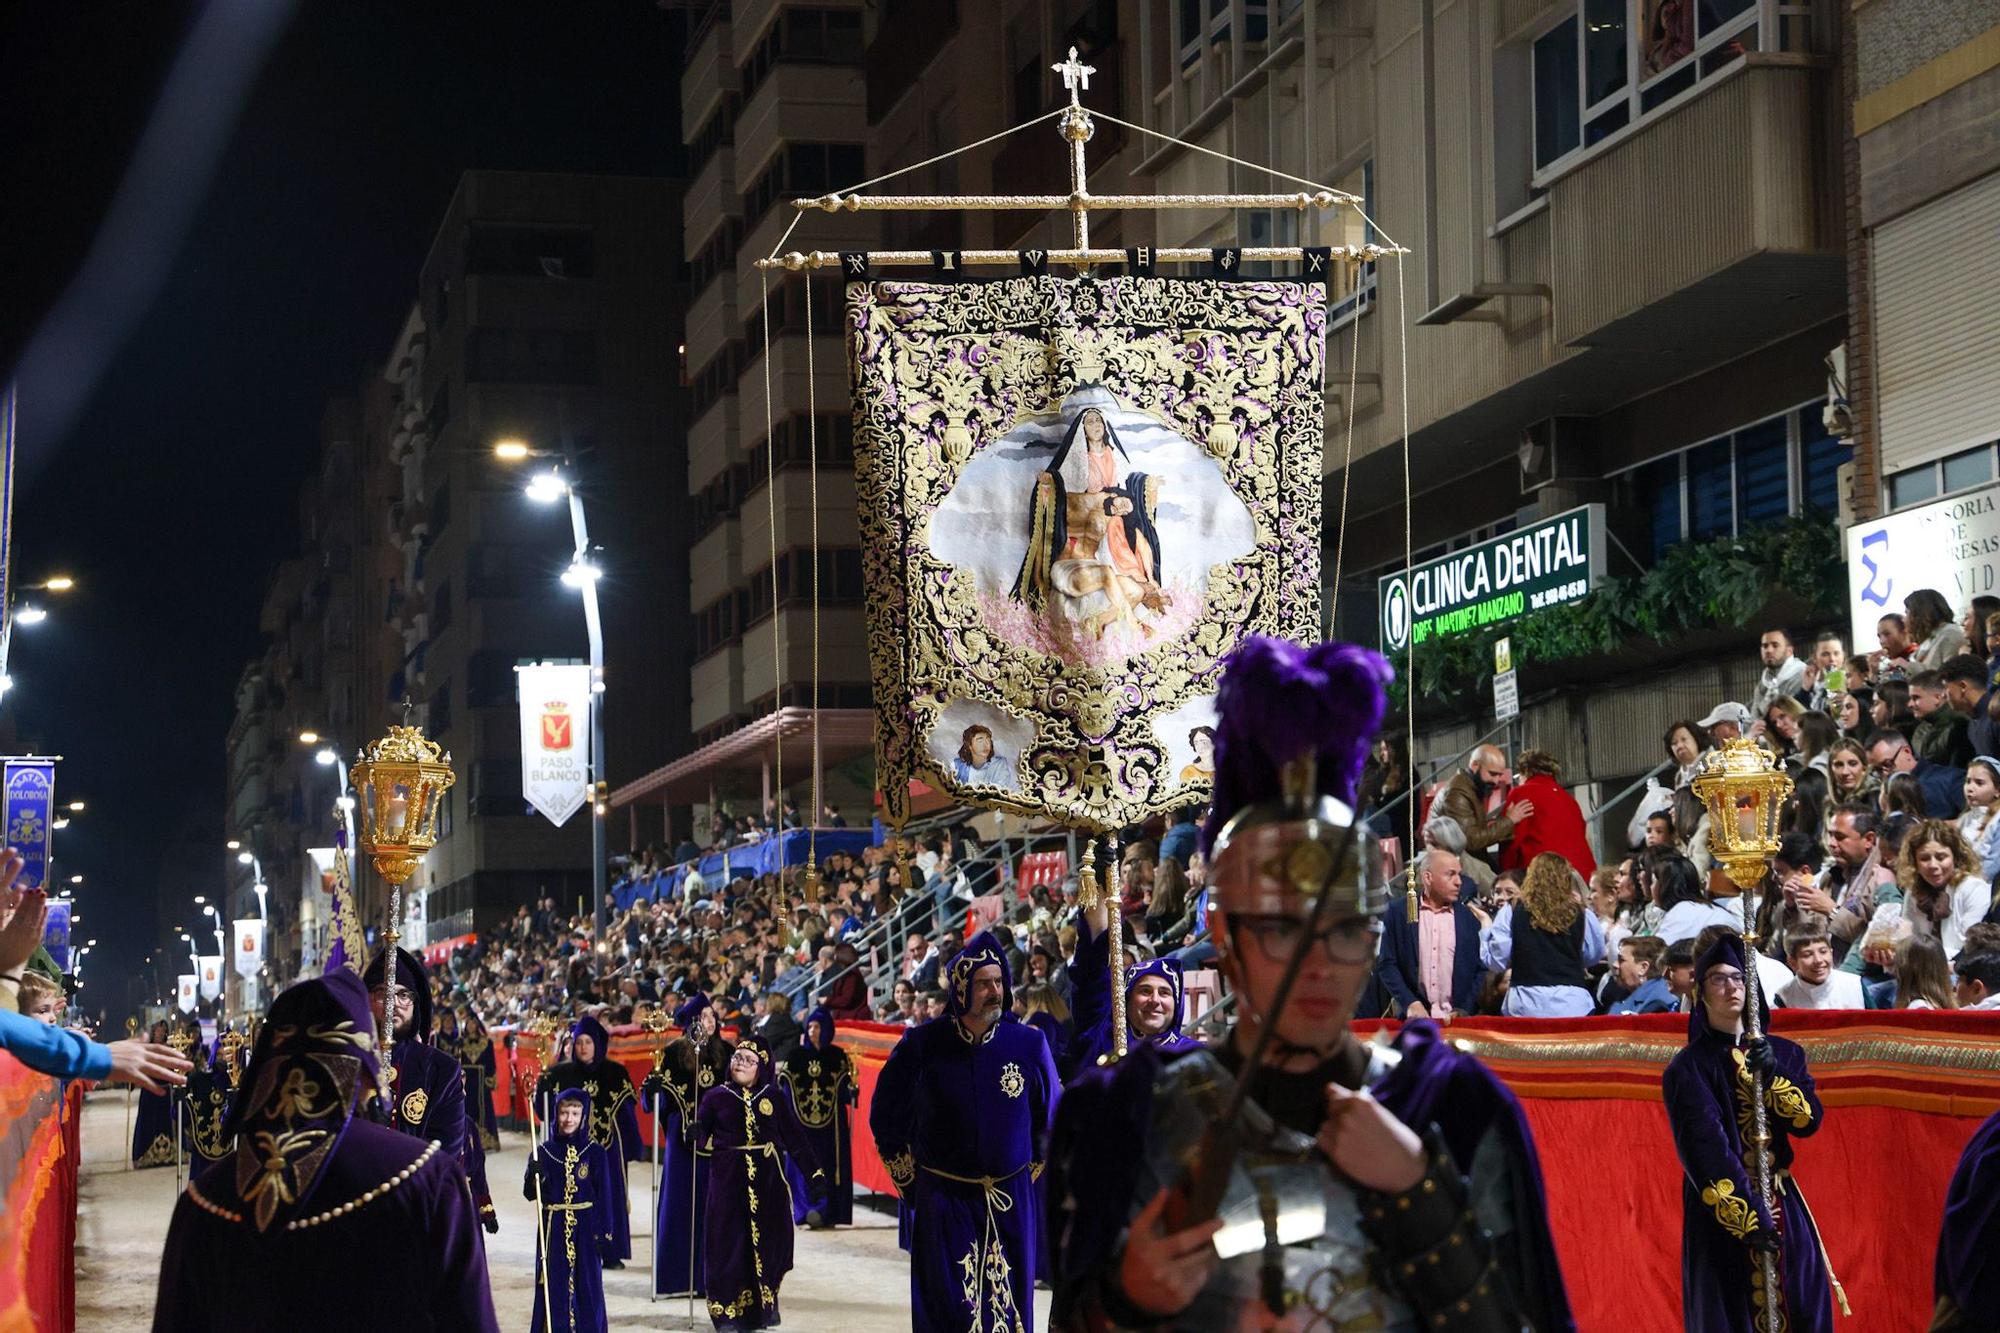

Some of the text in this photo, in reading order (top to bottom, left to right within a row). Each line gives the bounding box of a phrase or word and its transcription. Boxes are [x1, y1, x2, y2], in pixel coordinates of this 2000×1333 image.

[1411, 518, 1586, 615] CLINICA DENTAL
[1436, 605, 1477, 636] MARTINEZ
[1478, 591, 1524, 625] MANZANO
[540, 757, 573, 768] PASO
[531, 770, 581, 781] BLANCO
[10, 790, 47, 800] DOLOROSA
